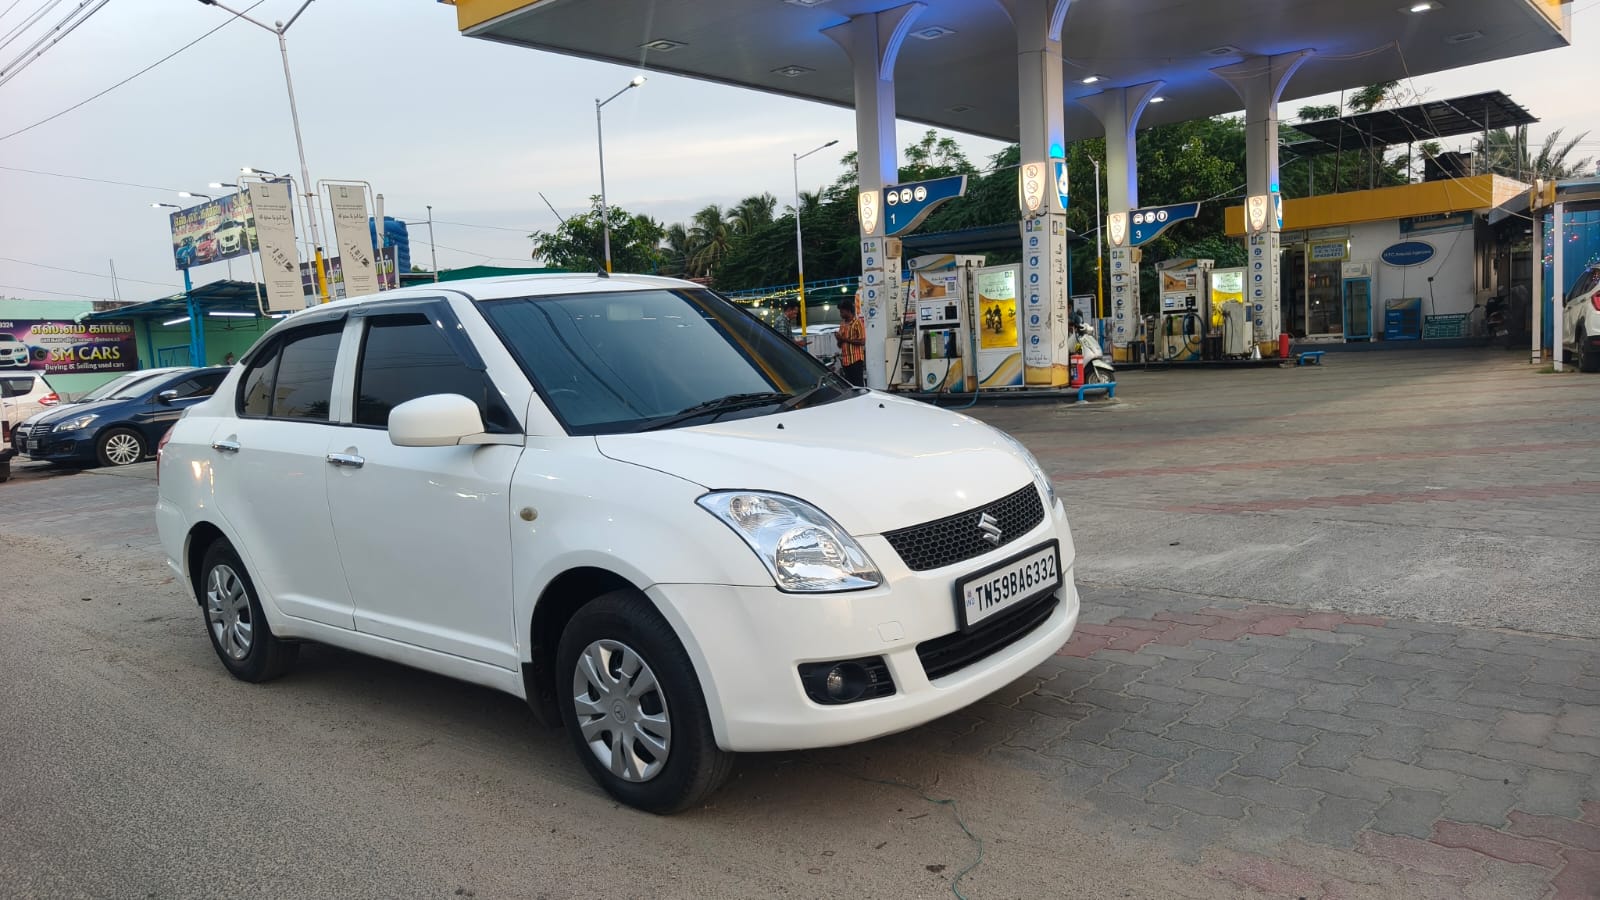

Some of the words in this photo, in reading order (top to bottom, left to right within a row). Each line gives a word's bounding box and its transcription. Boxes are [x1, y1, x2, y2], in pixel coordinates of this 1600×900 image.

[890, 213, 896, 224] 1
[1135, 230, 1142, 239] 3
[51, 347, 76, 362] SM
[78, 346, 121, 361] CARS
[45, 363, 68, 371] Buying
[76, 362, 98, 370] Selling
[975, 555, 1055, 611] TN59BA6332
